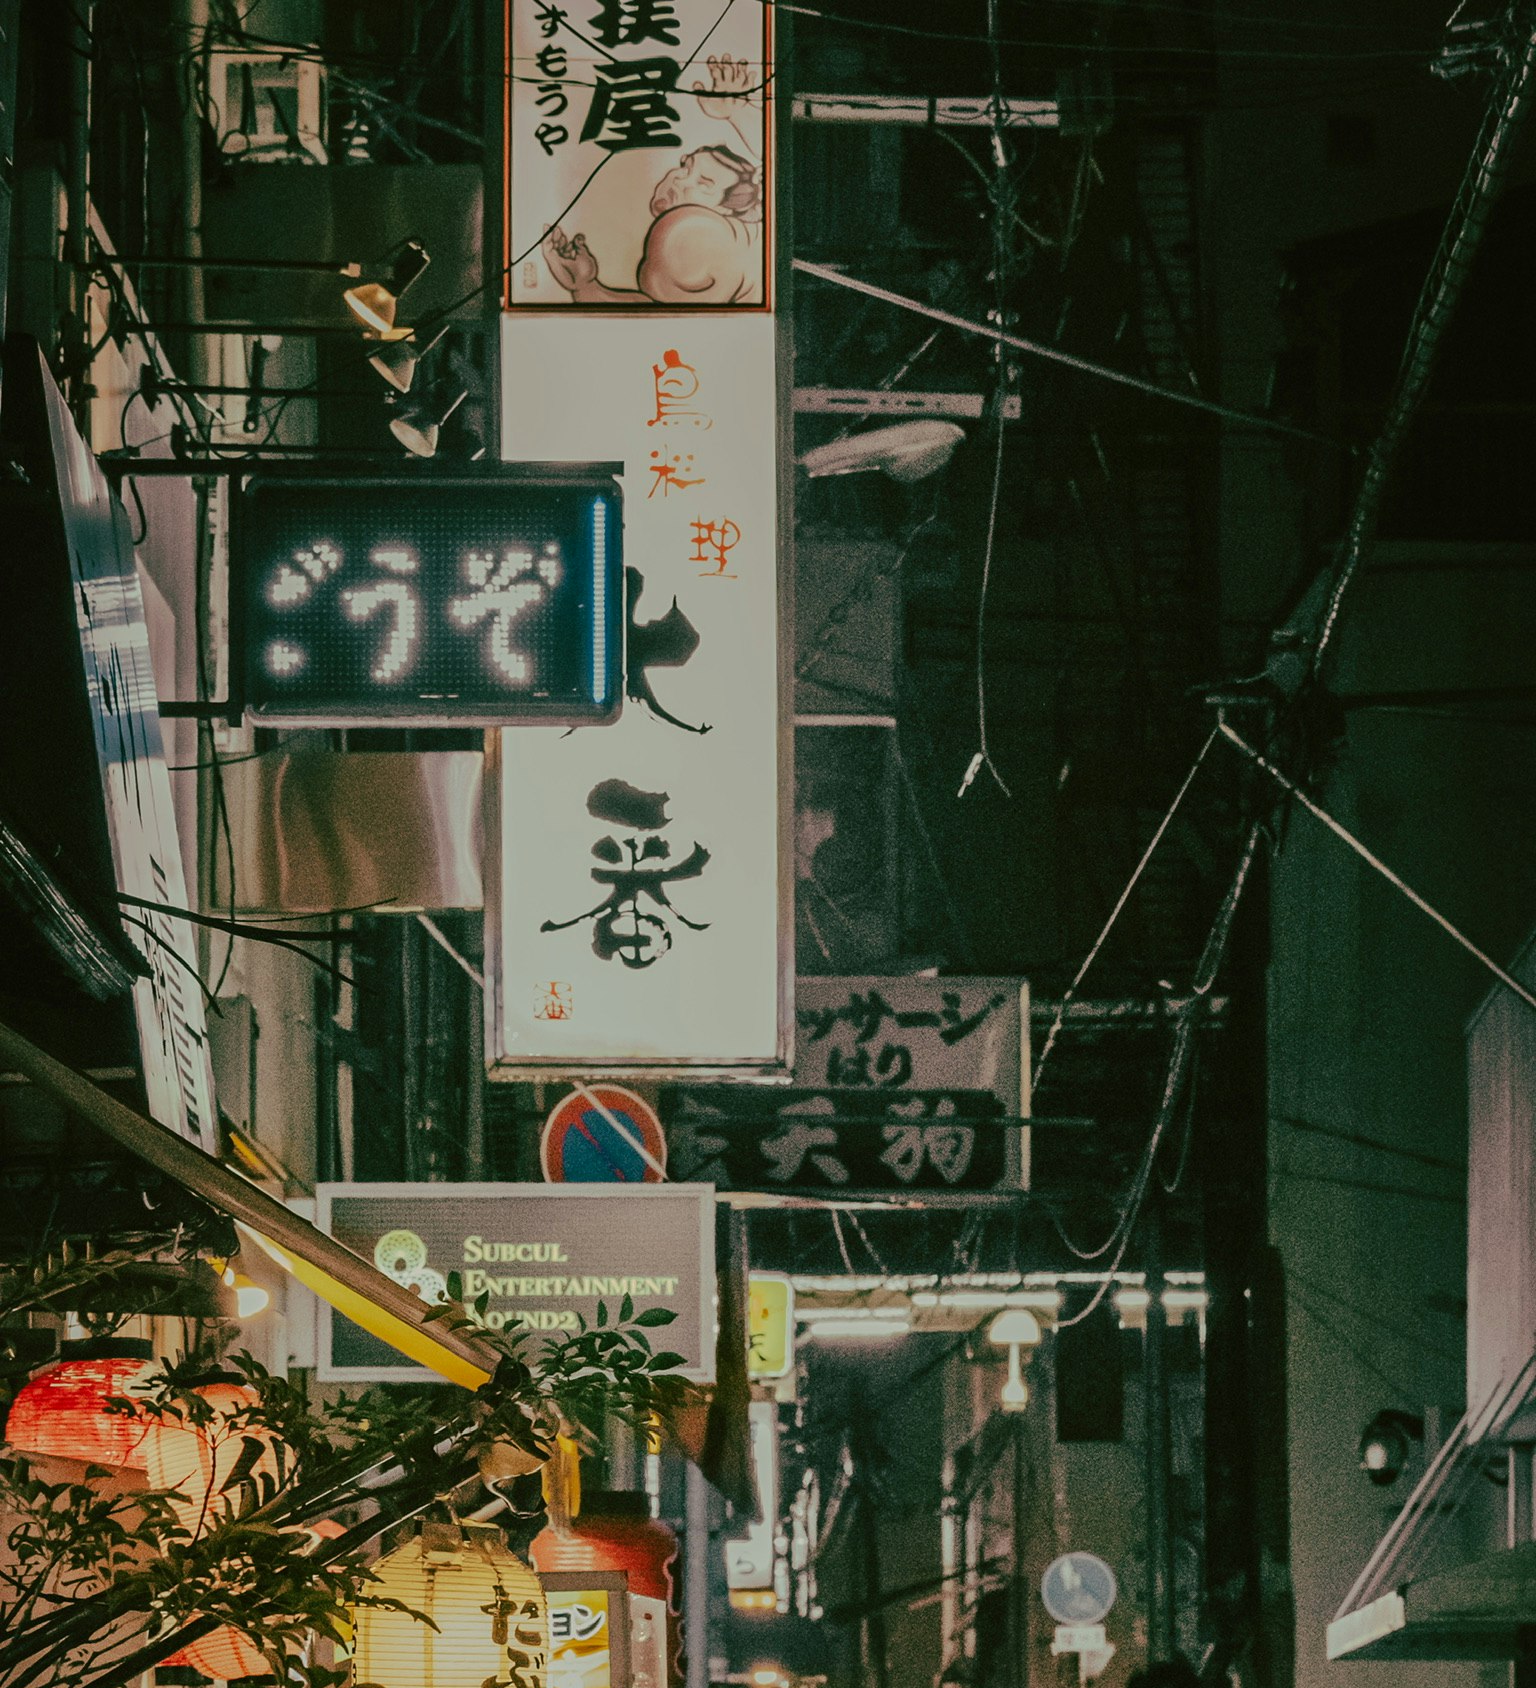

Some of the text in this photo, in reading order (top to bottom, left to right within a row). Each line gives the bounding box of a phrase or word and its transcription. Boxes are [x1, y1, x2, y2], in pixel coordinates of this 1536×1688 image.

[534, 4, 569, 156] すもうや
[646, 349, 741, 579] 鳥料理
[463, 1269, 679, 1297] ENTERTAINMENT
